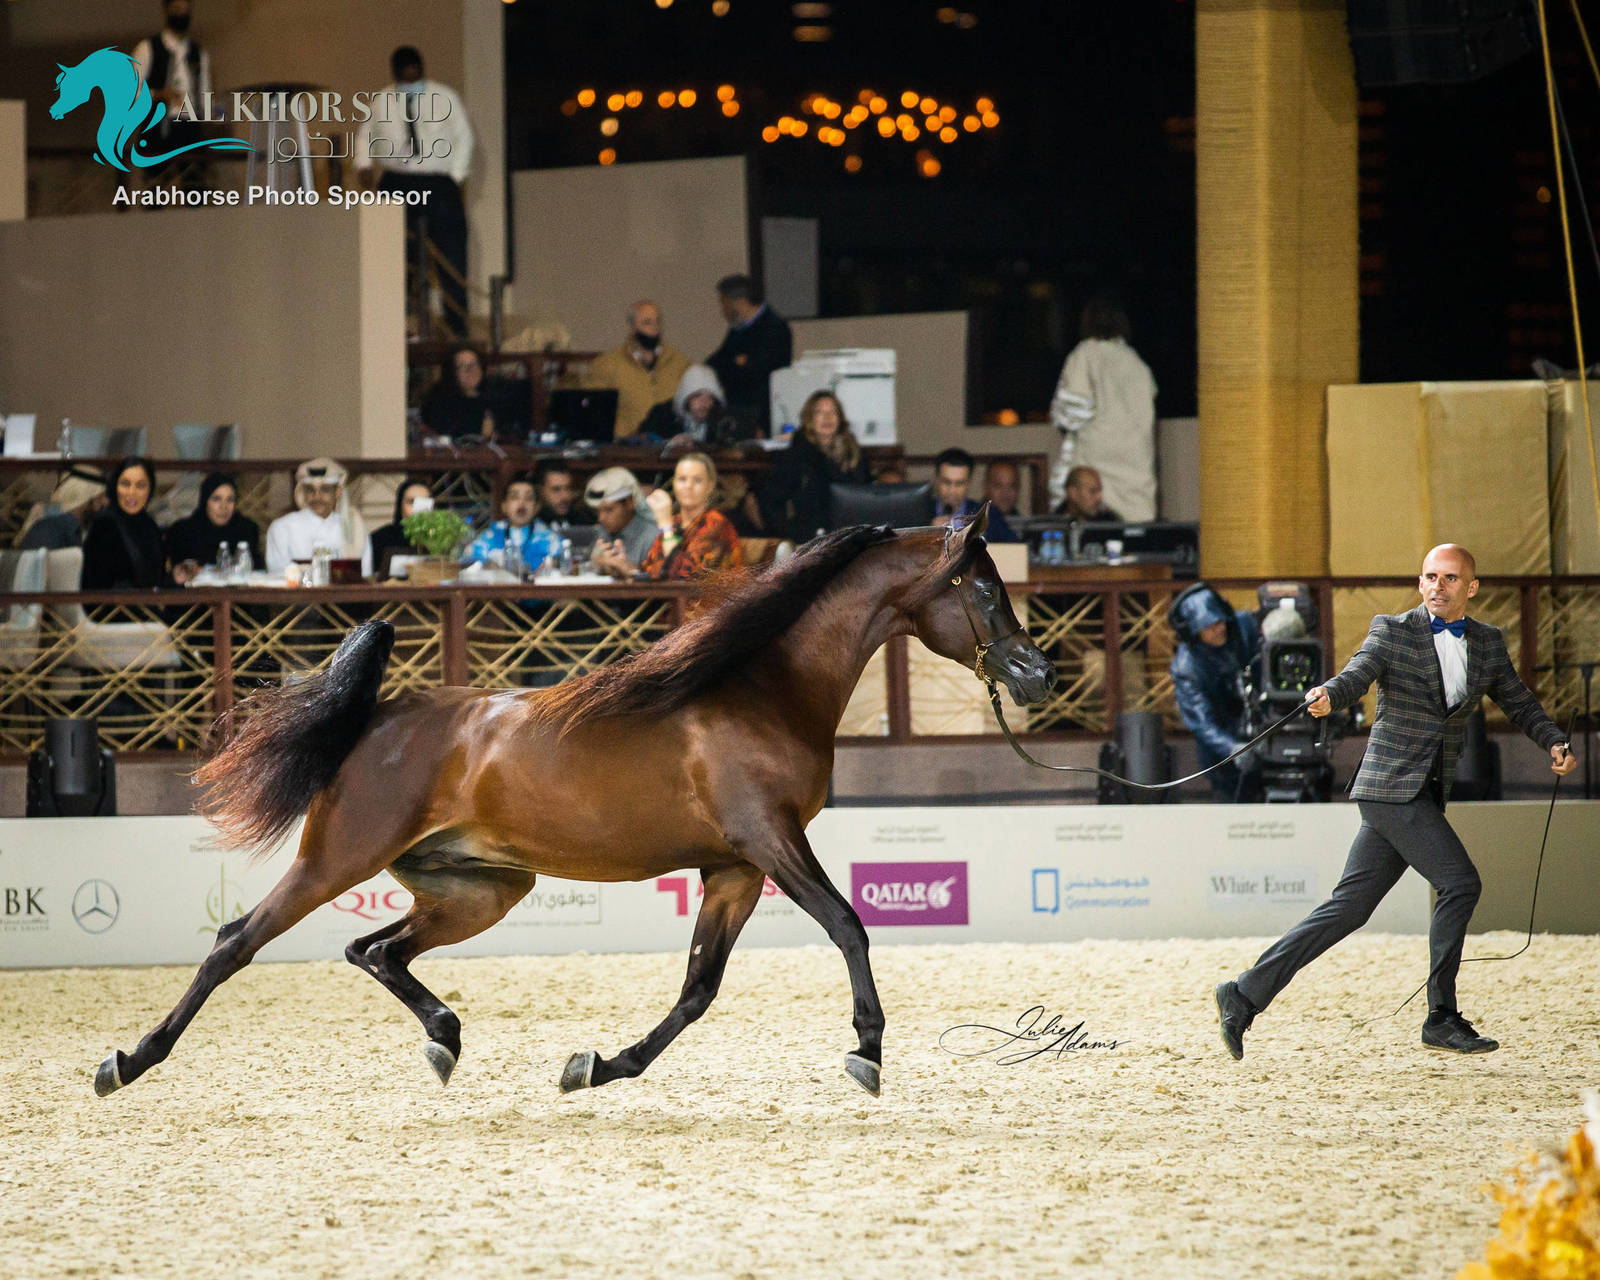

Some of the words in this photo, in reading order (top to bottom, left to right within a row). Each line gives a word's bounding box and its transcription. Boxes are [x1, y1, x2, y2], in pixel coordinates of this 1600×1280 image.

[861, 882, 927, 908] QATAR
[1210, 875, 1259, 895] White
[1263, 875, 1306, 895] Event
